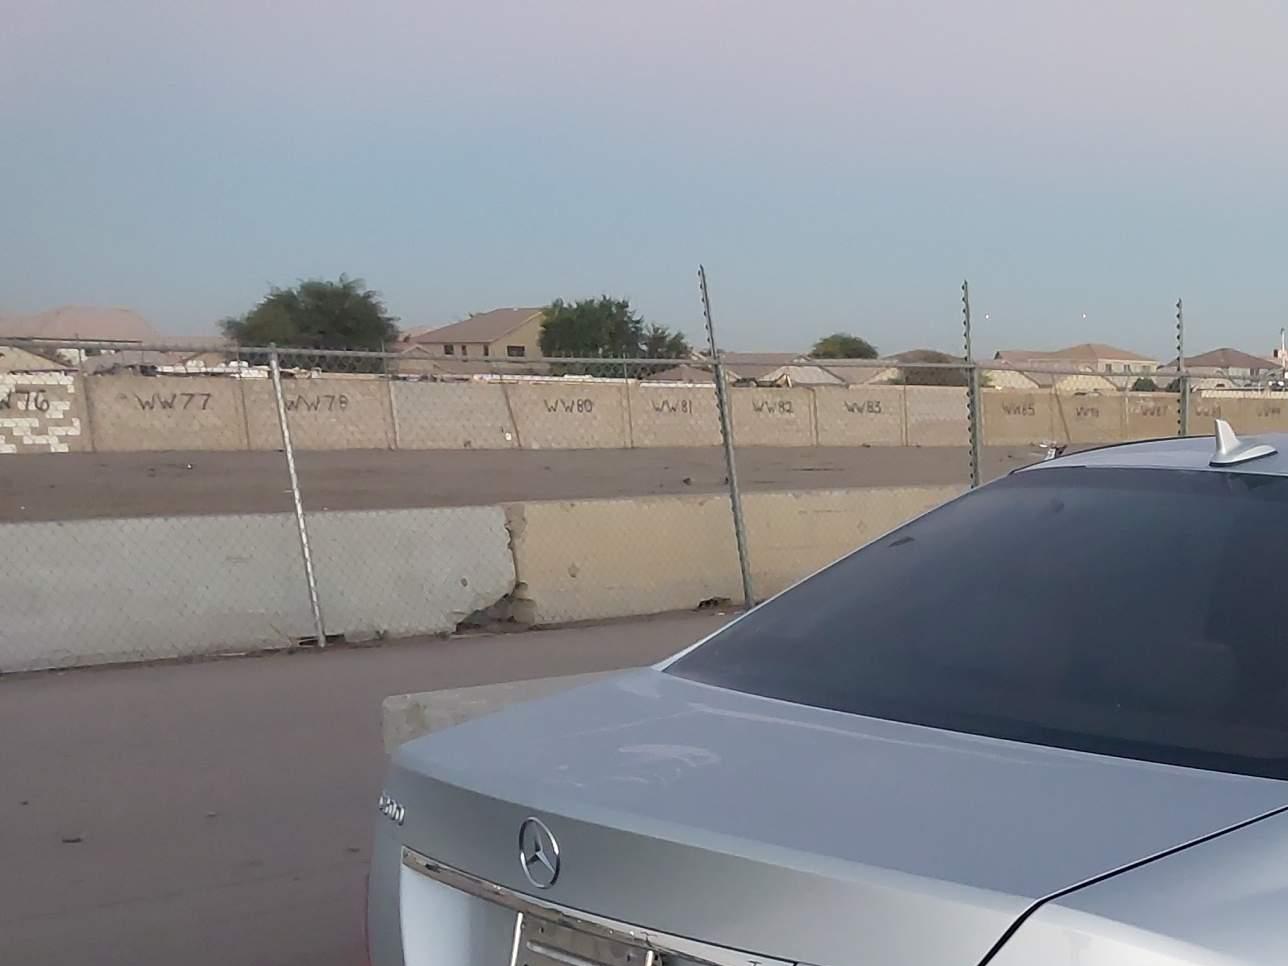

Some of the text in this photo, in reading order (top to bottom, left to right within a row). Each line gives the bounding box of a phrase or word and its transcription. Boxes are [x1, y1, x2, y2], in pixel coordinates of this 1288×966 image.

[134, 392, 212, 411] WW77
[544, 399, 593, 413] WW80
[651, 399, 692, 414] WW81
[752, 400, 794, 414] WW82
